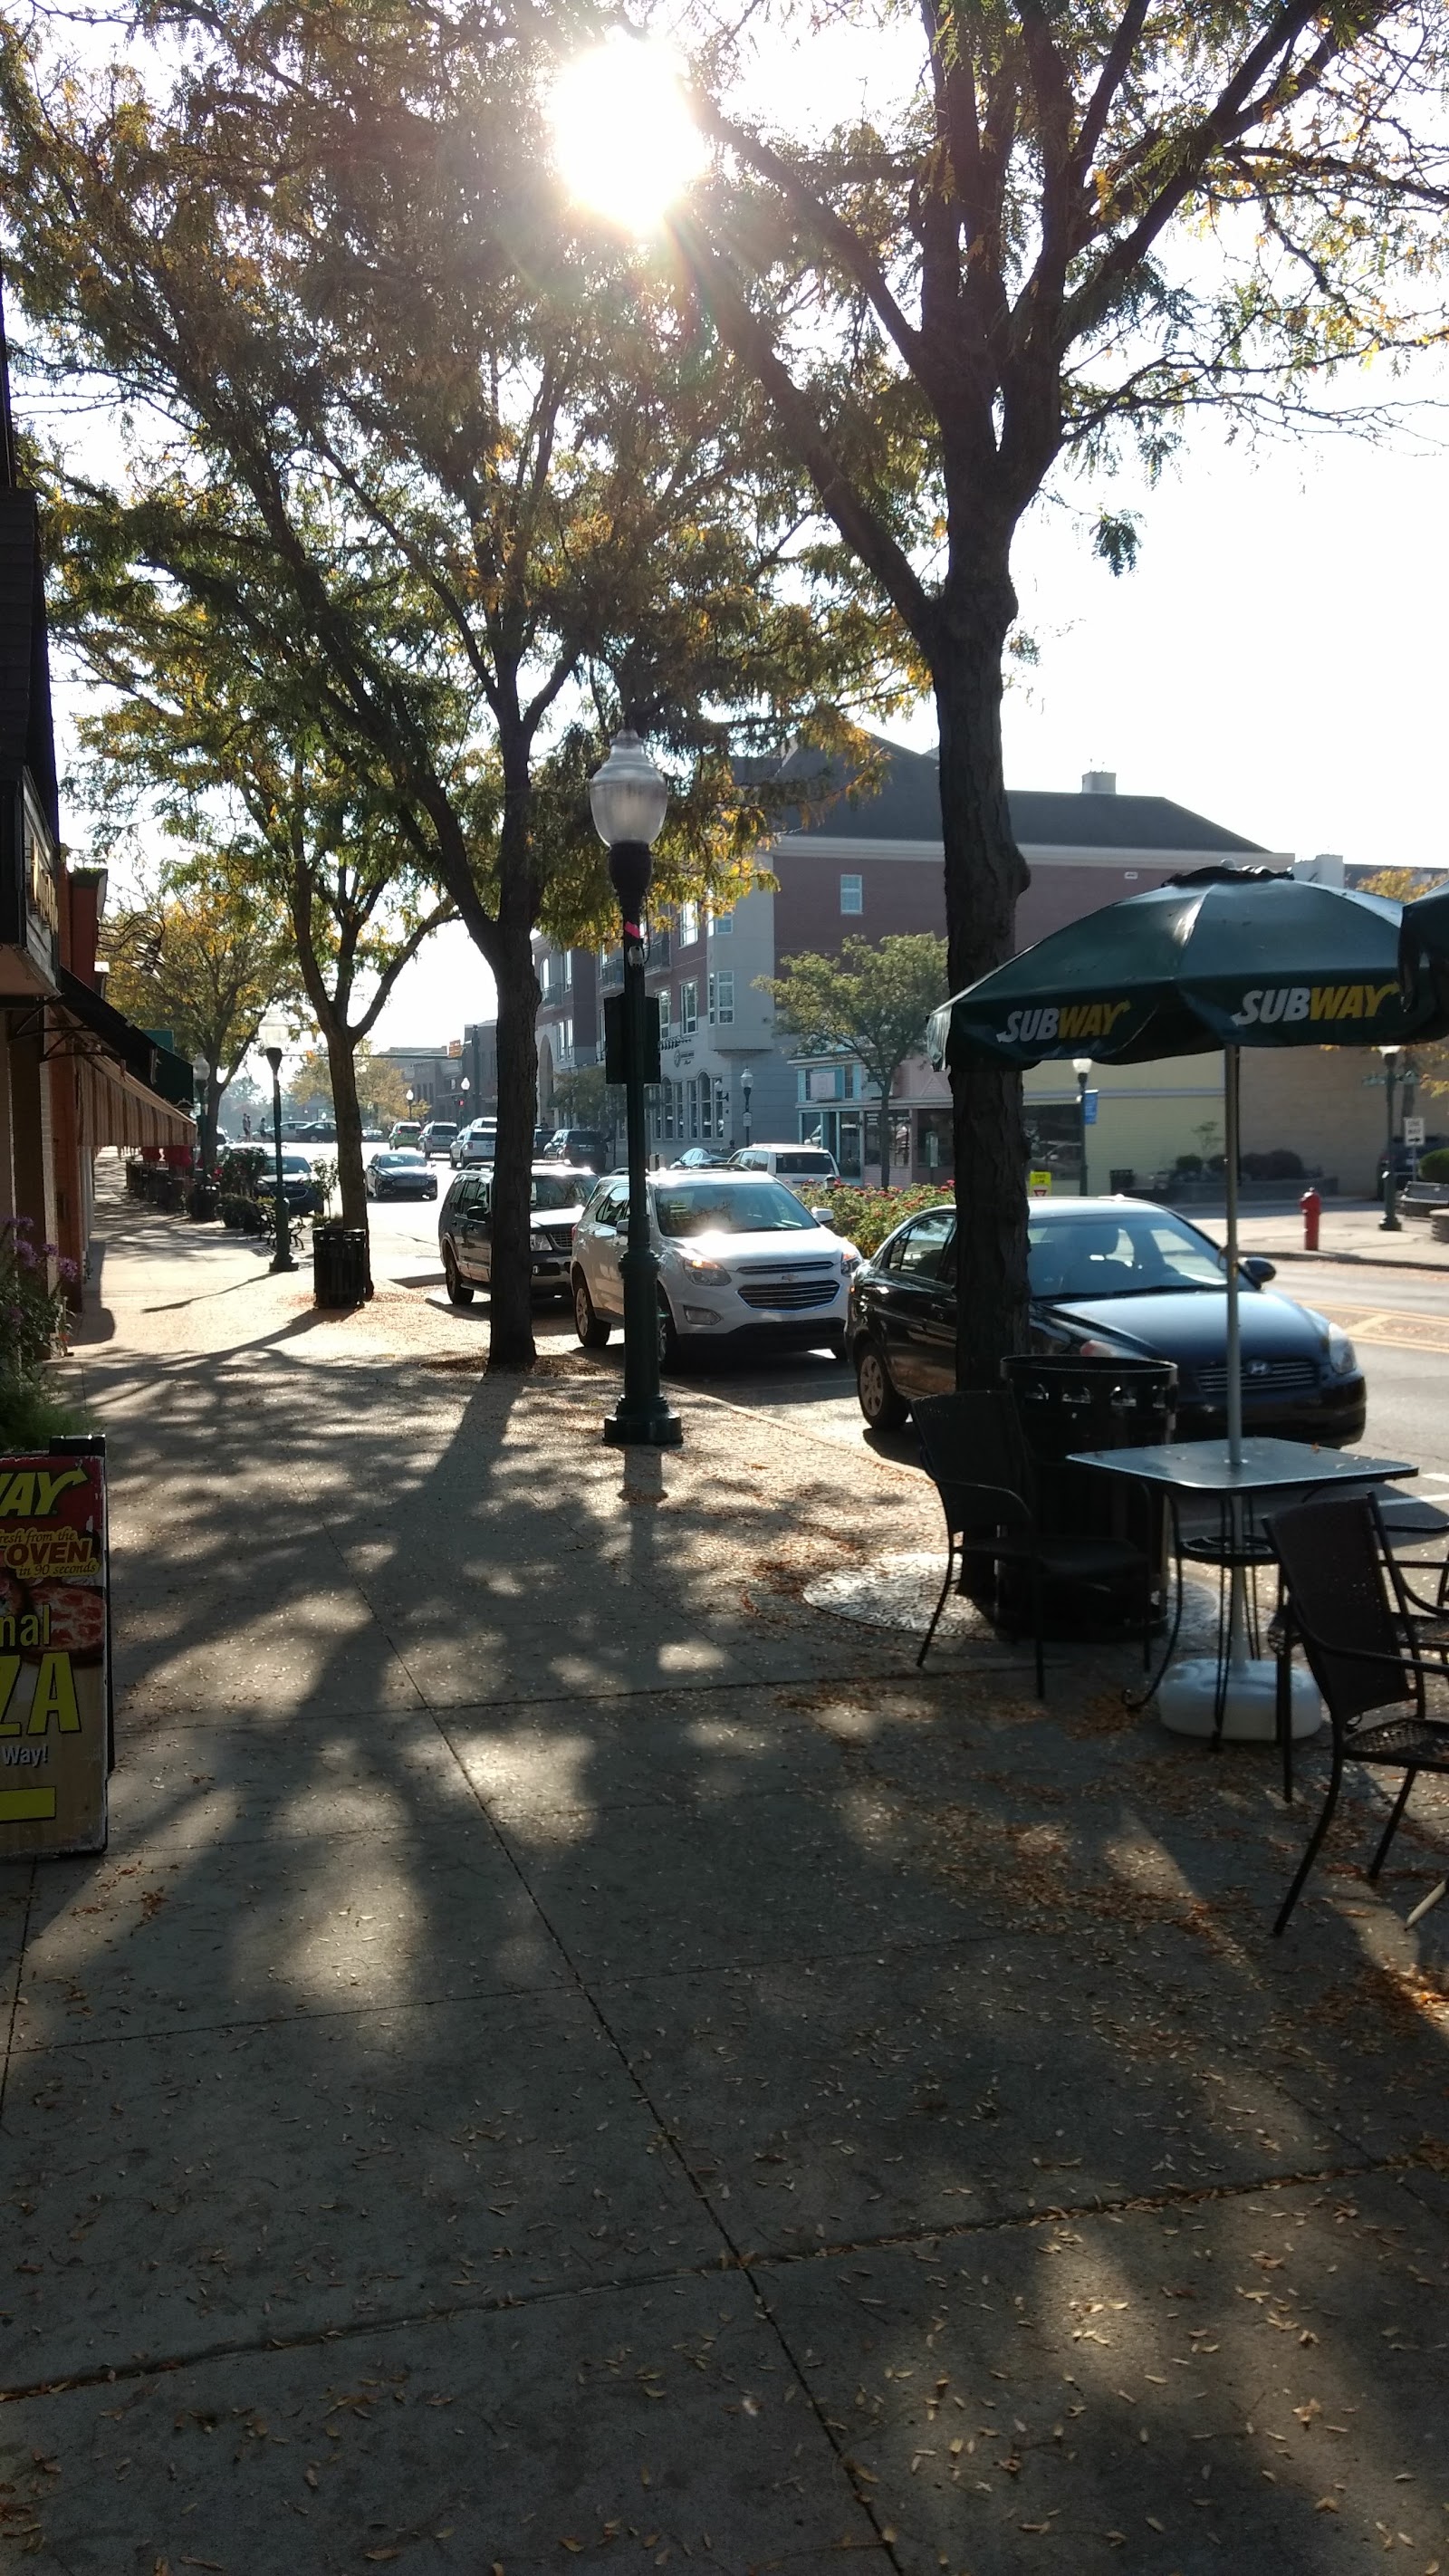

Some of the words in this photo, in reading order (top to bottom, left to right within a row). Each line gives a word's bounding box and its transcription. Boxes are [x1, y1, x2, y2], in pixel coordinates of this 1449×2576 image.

[1234, 981, 1401, 1026] SUBWAY
[996, 999, 1131, 1043] SUBWAY
[26, 1532, 53, 1544] from
[58, 1531, 75, 1542] the
[6, 1541, 90, 1567] OVEN
[18, 1566, 31, 1576] in
[34, 1564, 50, 1575] 90
[53, 1561, 97, 1574] seconds
[2, 1745, 49, 1767] Way!
